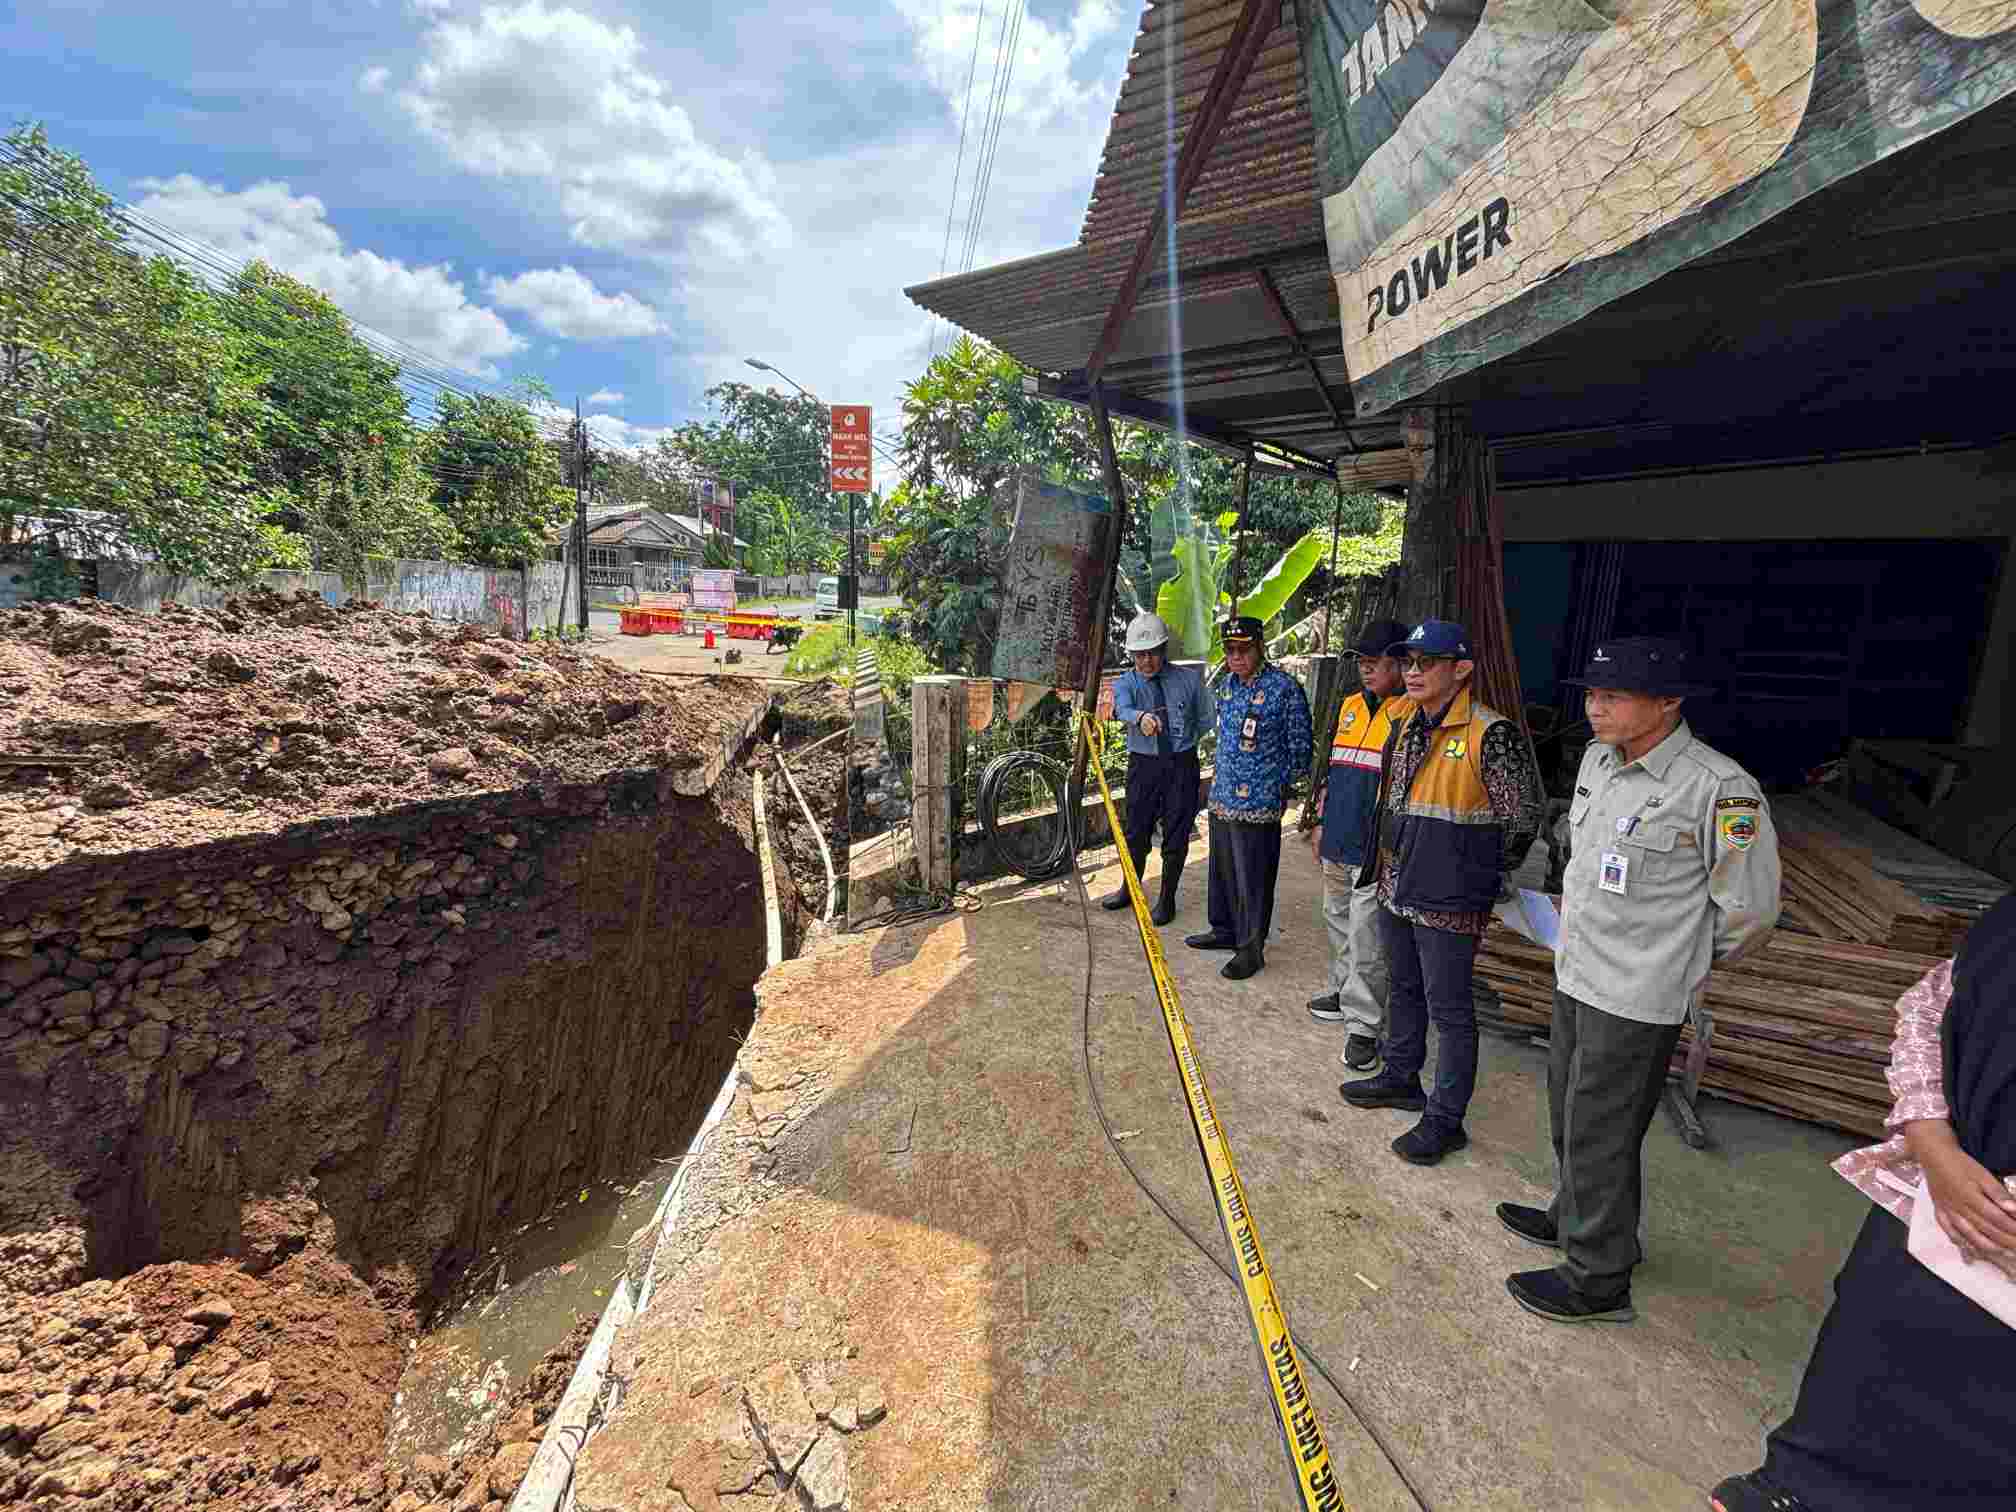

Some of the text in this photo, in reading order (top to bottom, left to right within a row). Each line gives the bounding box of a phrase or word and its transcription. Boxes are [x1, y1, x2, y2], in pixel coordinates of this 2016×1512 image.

[1367, 196, 1512, 334] POWER
[1236, 1224, 1264, 1278] GARIS
[1270, 1333, 1324, 1463] MELINTAS
